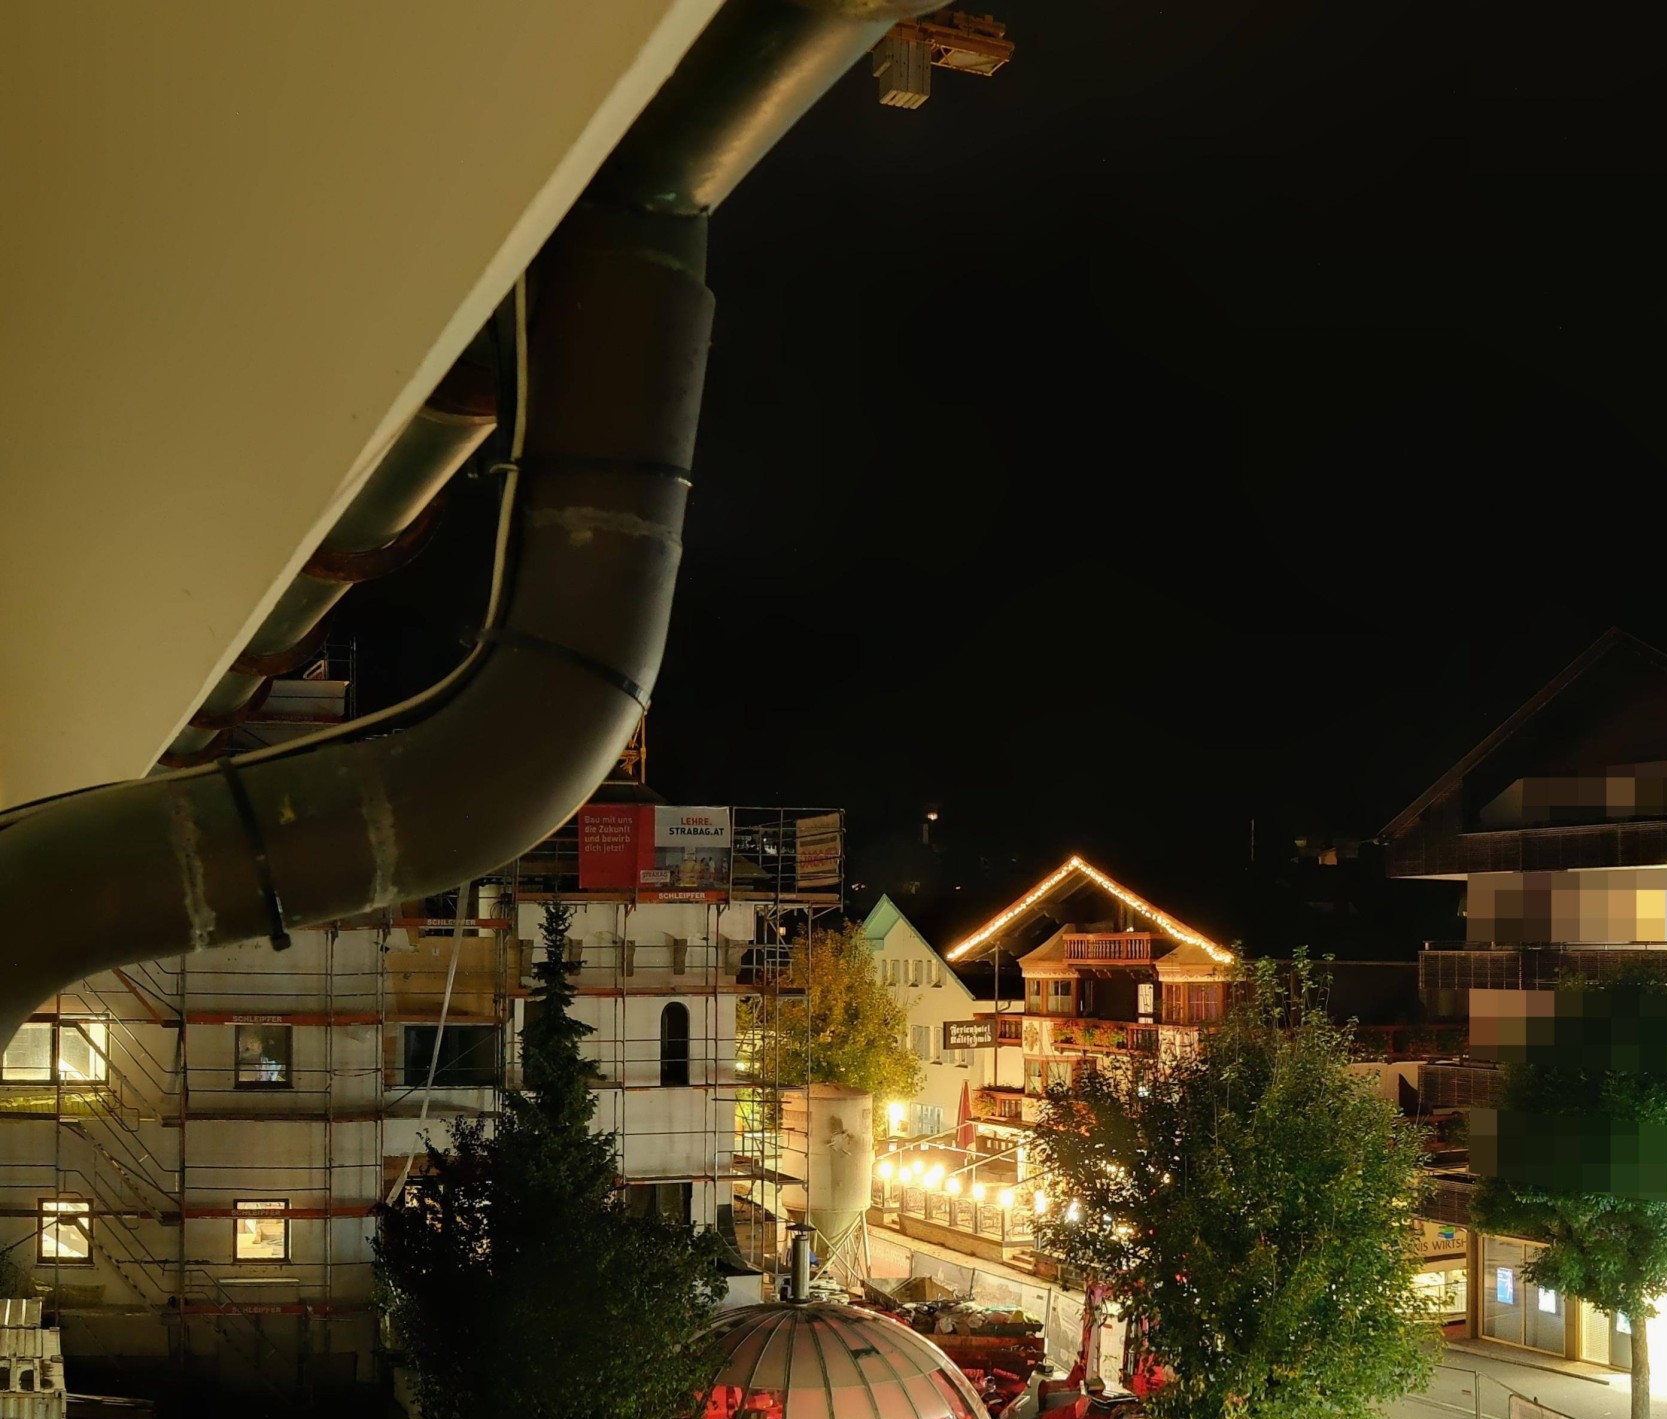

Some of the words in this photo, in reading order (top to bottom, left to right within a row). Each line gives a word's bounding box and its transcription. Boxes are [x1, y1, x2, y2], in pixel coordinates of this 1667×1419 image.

[584, 815, 601, 824] Bau
[602, 815, 617, 824] mit
[618, 816, 633, 824] uns
[681, 817, 713, 826] LEHRE.
[584, 825, 597, 833] die
[598, 825, 631, 833] Zukunft
[669, 827, 725, 836] STRABAG.AT
[584, 834, 599, 843] und
[601, 834, 631, 843] bewirb
